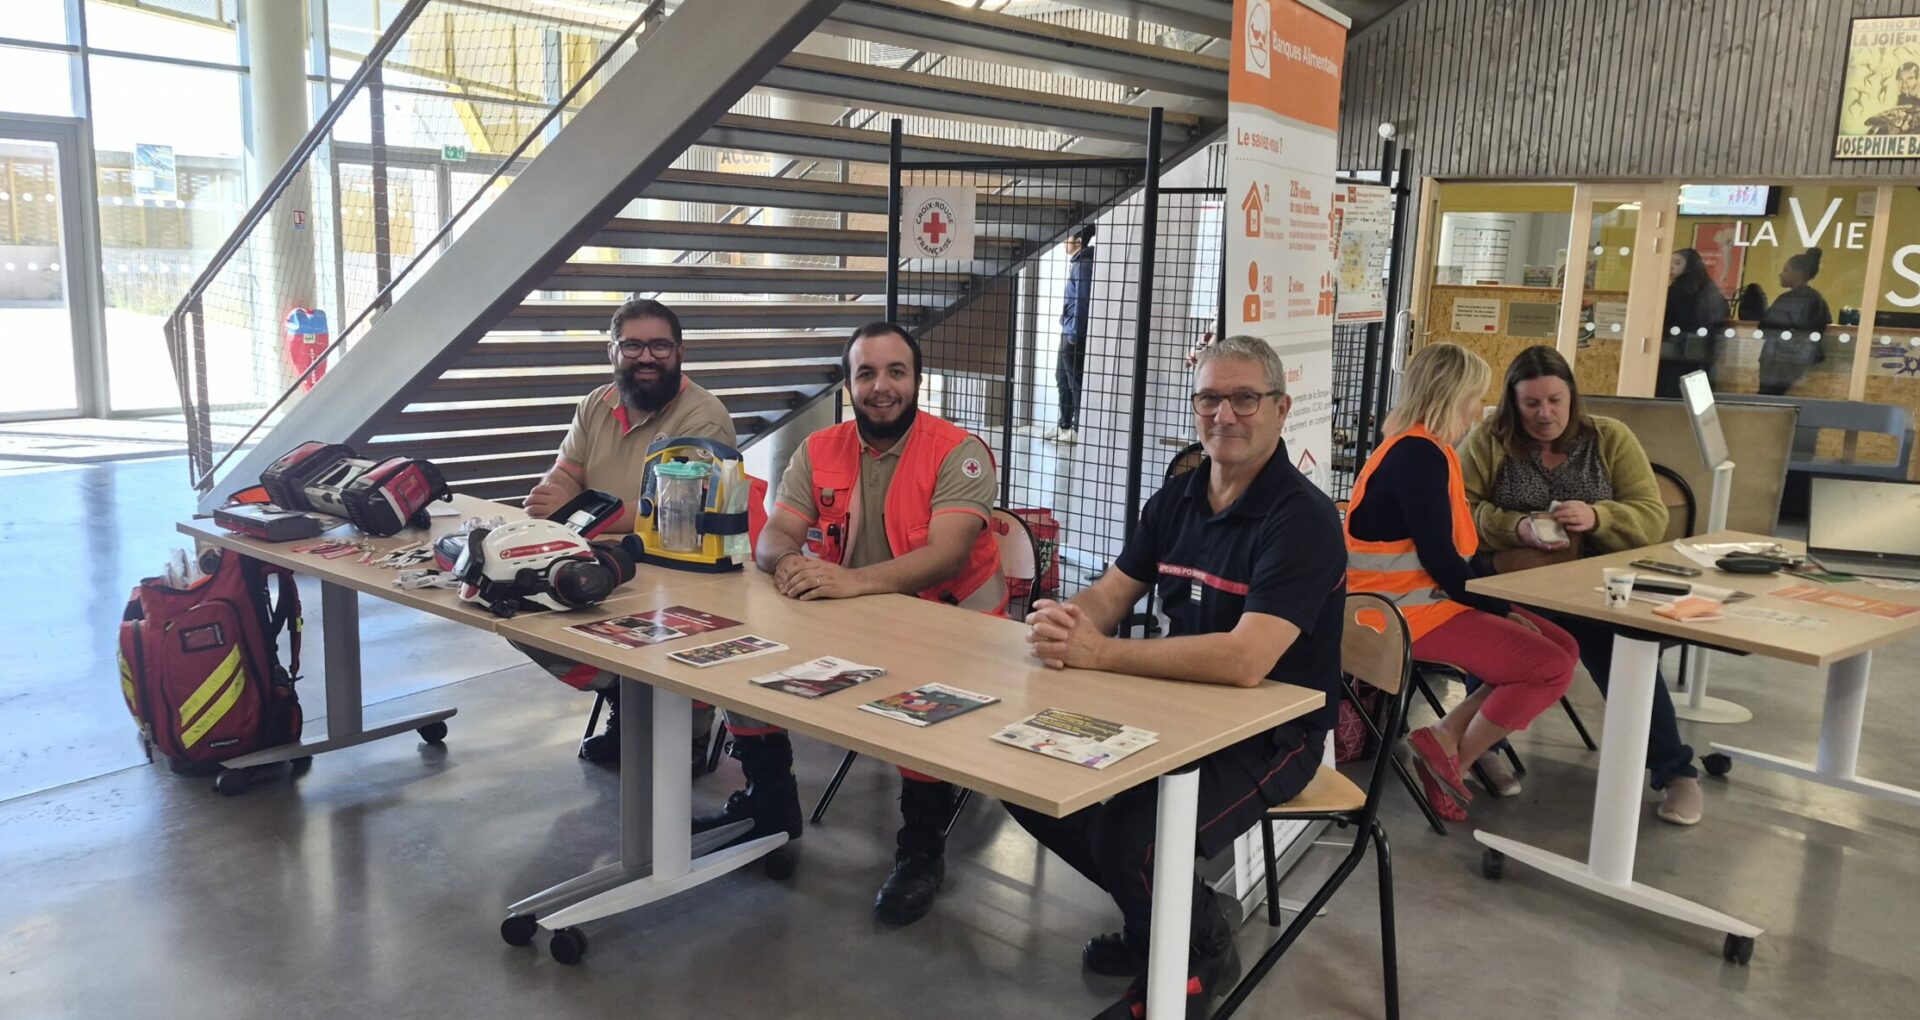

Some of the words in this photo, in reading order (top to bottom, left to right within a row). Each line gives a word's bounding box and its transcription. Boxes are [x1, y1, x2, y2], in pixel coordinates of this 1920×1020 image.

[1854, 20, 1904, 30] CASINO
[1272, 29, 1302, 62] Banques
[1853, 34, 1869, 47] LA
[1871, 32, 1905, 47] JOIE
[1905, 35, 1917, 43] DE
[1237, 126, 1250, 147] Le
[1836, 136, 1906, 156] JOSEPHINE
[915, 200, 954, 225] CROIX-ROUGE
[1733, 220, 1779, 248] LA
[916, 235, 952, 256] FRANÇAISE
